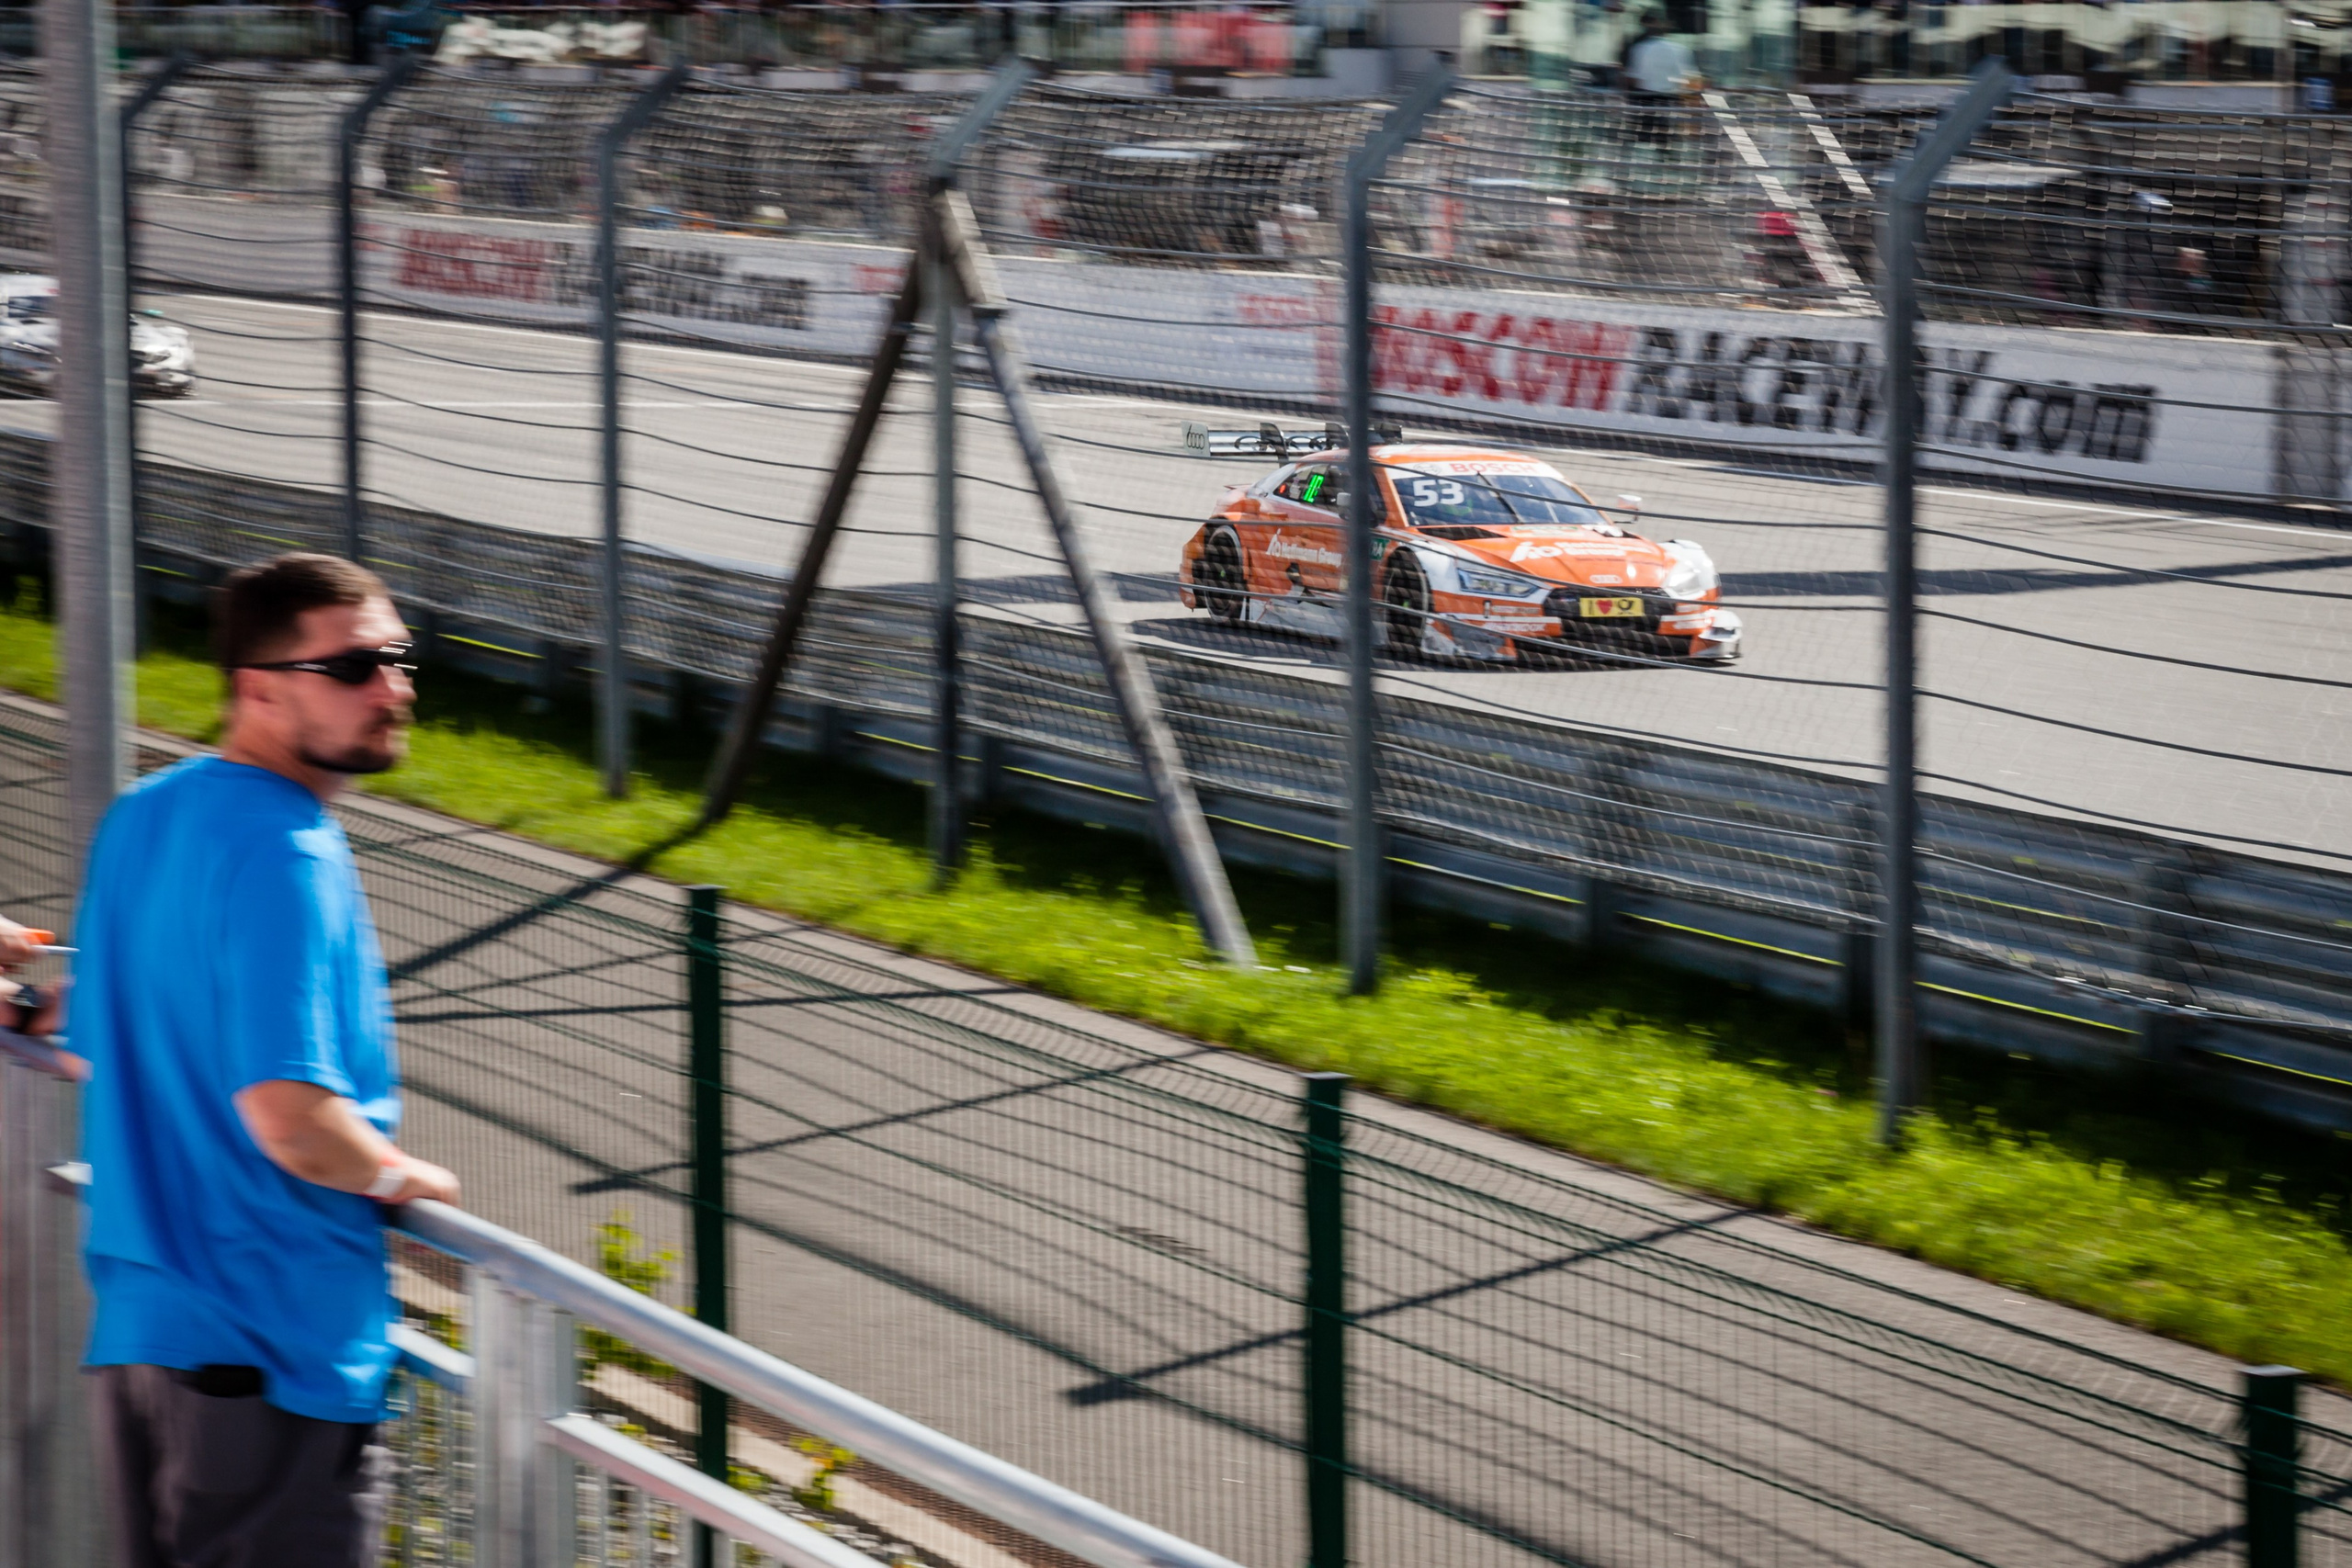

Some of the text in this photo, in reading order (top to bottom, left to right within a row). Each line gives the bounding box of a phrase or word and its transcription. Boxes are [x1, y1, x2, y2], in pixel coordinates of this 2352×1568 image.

[1623, 325, 2159, 462] RACEWY.com
[1449, 463, 1538, 474] BOSCH
[1413, 479, 1465, 507] 53
